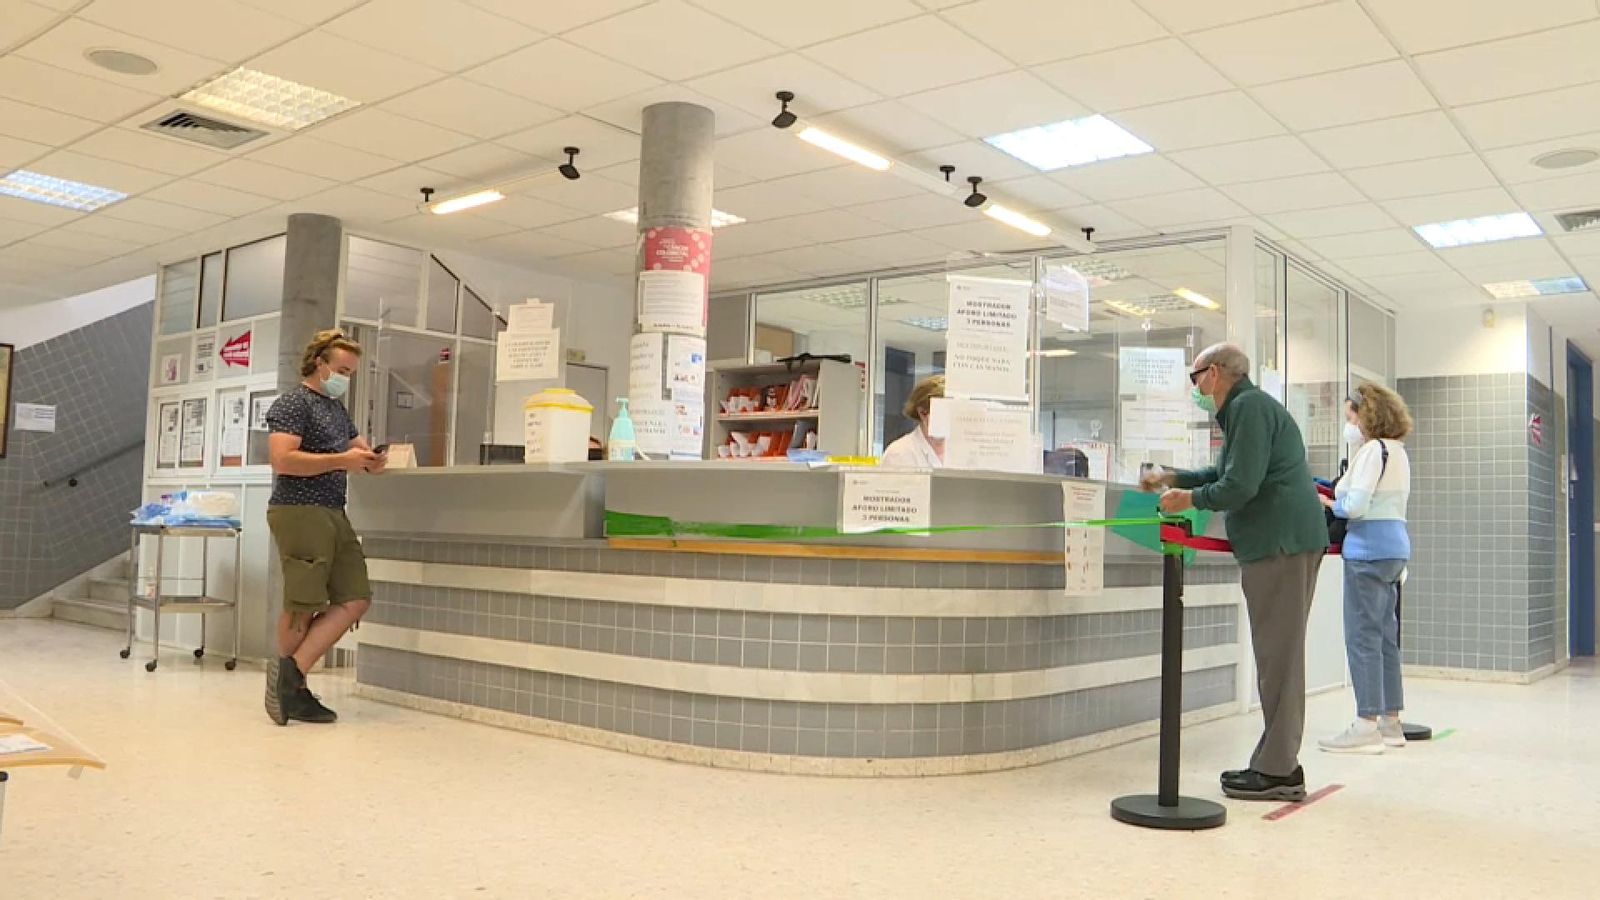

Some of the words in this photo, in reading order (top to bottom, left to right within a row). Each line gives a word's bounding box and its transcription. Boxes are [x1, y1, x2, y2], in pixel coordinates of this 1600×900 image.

[966, 300, 1011, 310] MOSTRADOR
[983, 311, 1018, 320] LIMITADO
[972, 319, 1011, 328] PERSONAS
[863, 496, 911, 504] MOSTRADOR
[852, 504, 879, 512] AFORO
[880, 505, 918, 514] LIMITADO
[869, 515, 910, 523] PERSONAS
